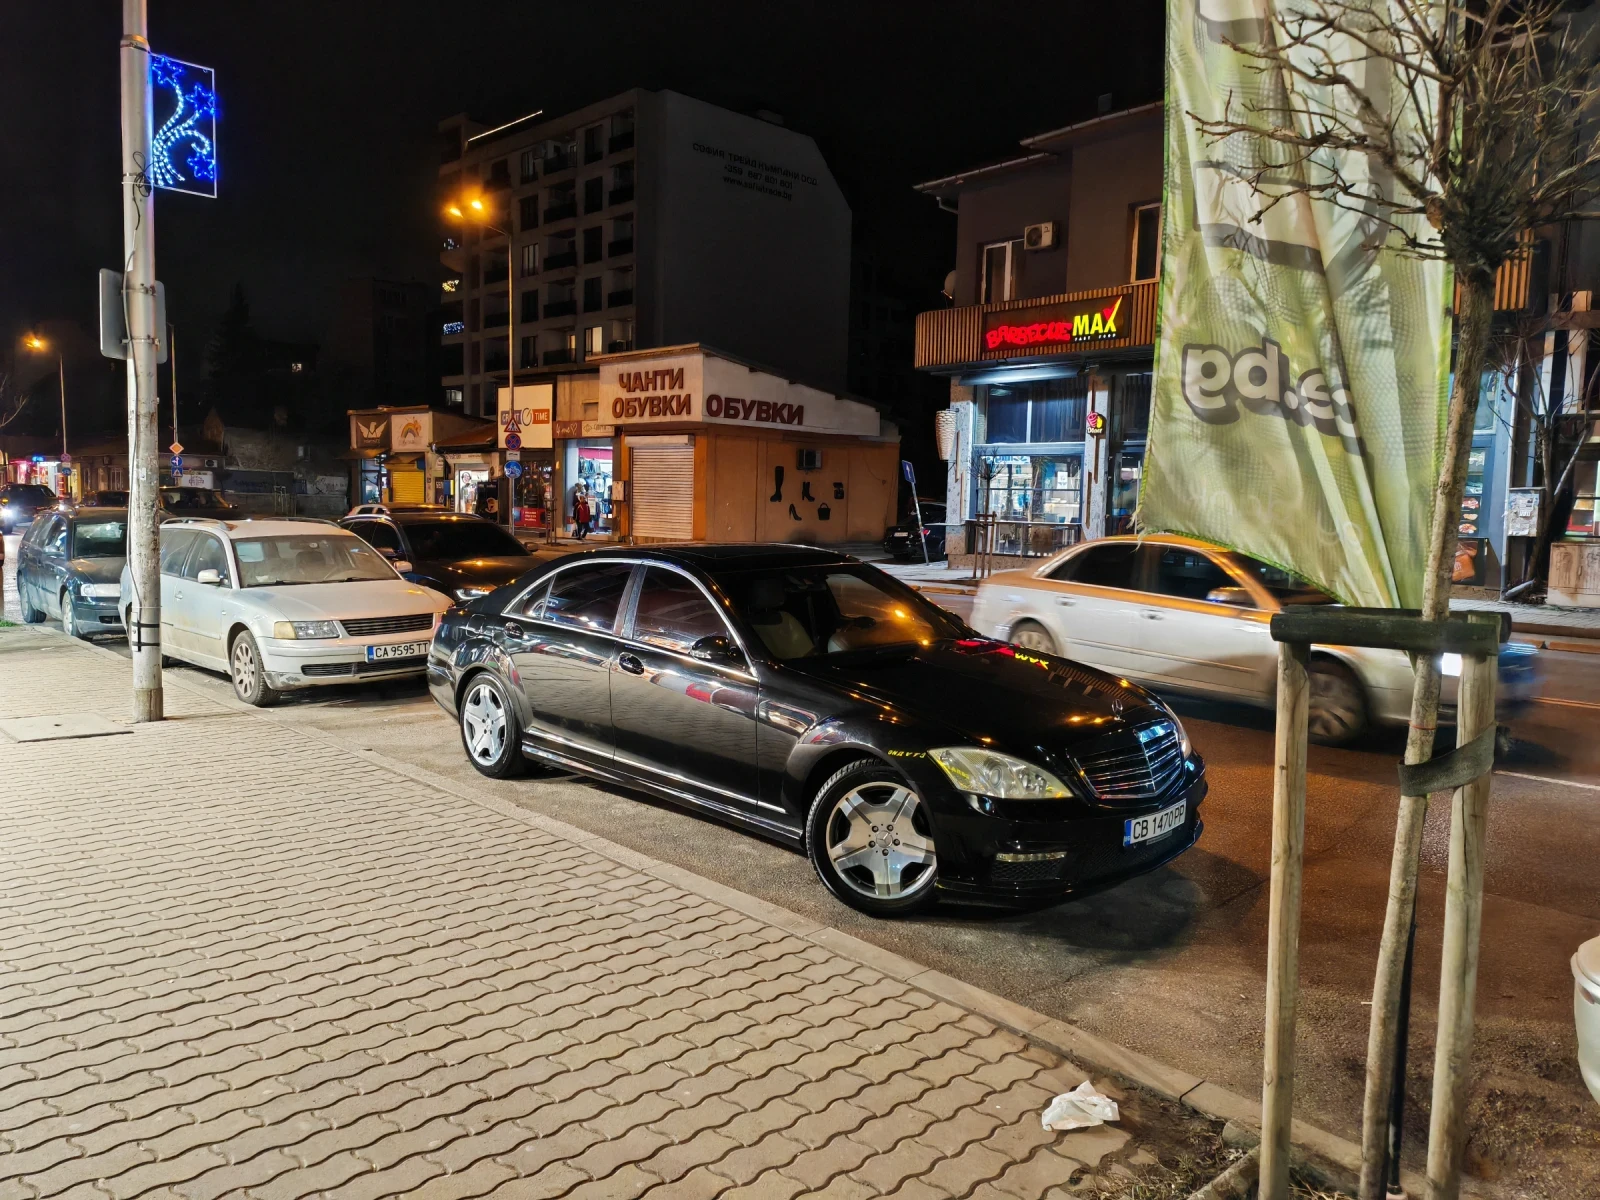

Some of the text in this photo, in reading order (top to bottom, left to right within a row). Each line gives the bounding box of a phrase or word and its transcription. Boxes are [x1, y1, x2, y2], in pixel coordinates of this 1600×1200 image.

[692, 142, 725, 160] СОФИЯ
[986, 296, 1123, 349] BARBECUE MAX
[618, 367, 684, 393] ЧАНТИ
[534, 412, 549, 422] TIME
[611, 393, 692, 419] ОБУВКИ
[705, 394, 805, 426] ОБУВКИ
[390, 643, 415, 657] 9595
